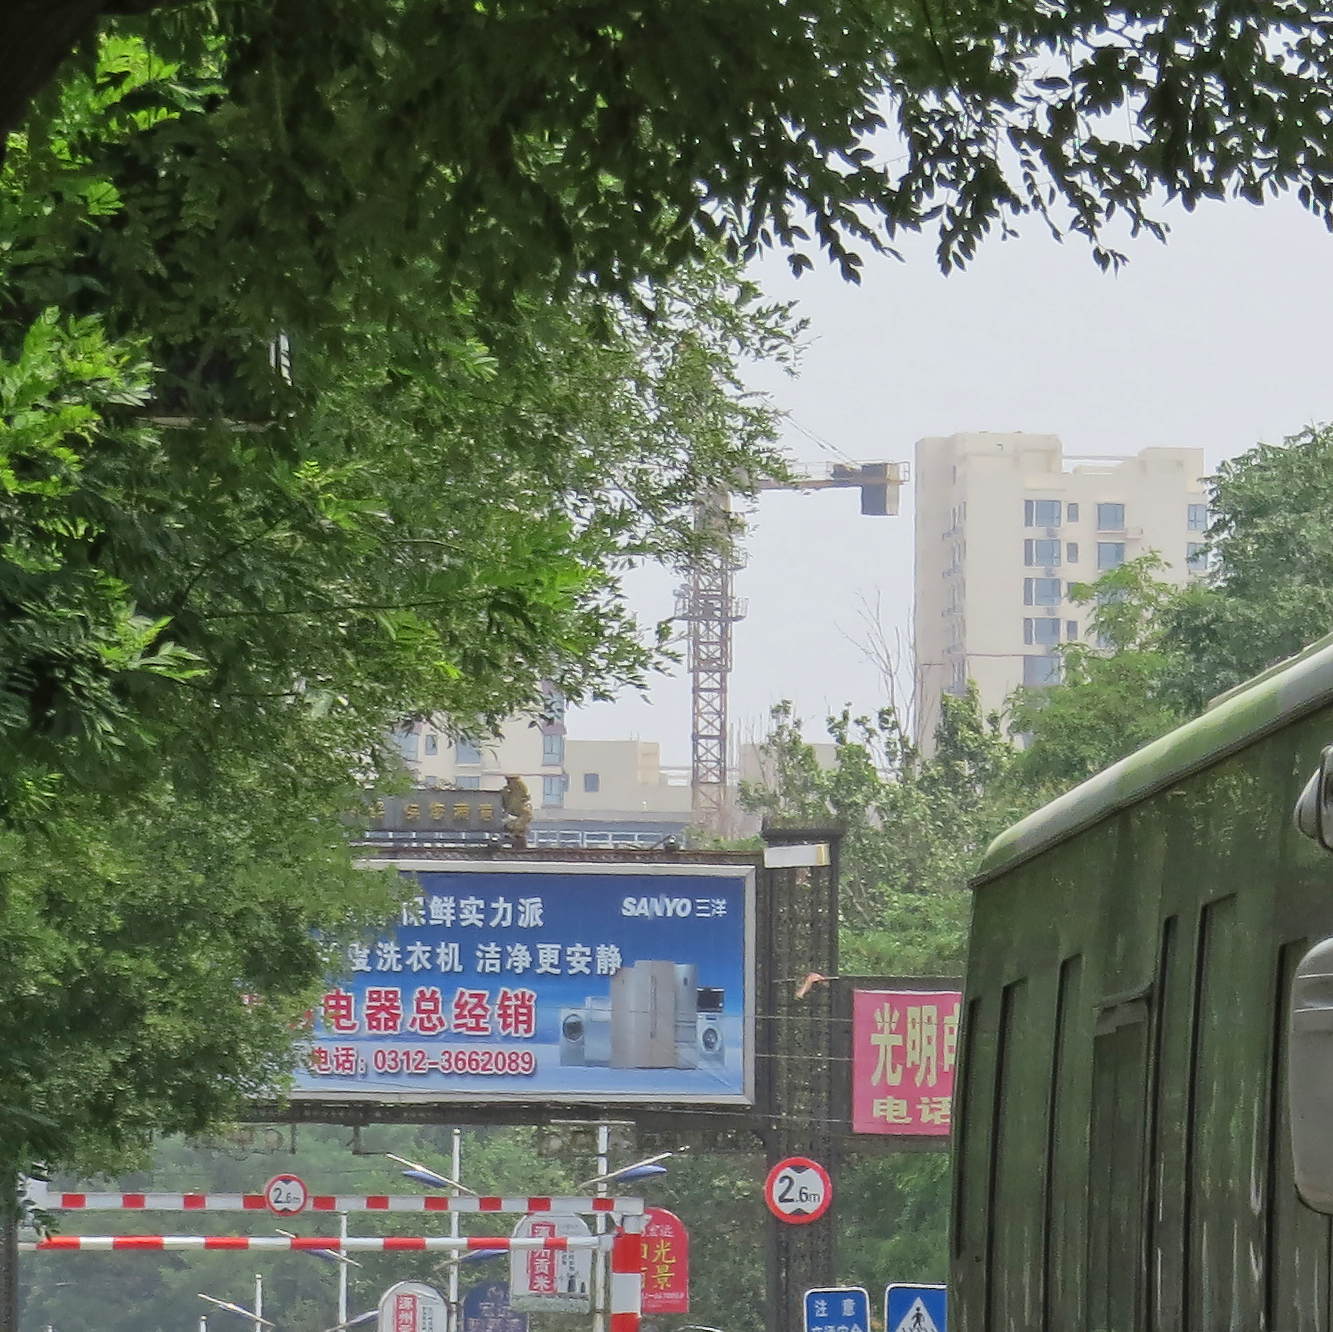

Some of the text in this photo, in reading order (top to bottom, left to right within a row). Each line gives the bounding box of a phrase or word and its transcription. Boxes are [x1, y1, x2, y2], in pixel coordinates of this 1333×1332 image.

[620, 895, 728, 918] SANYO 三洋
[475, 942, 623, 976] 洁净更安静
[310, 986, 538, 1039] 电器总经销
[872, 1095, 952, 1126] 电话
[777, 1174, 821, 1205] 2.6m
